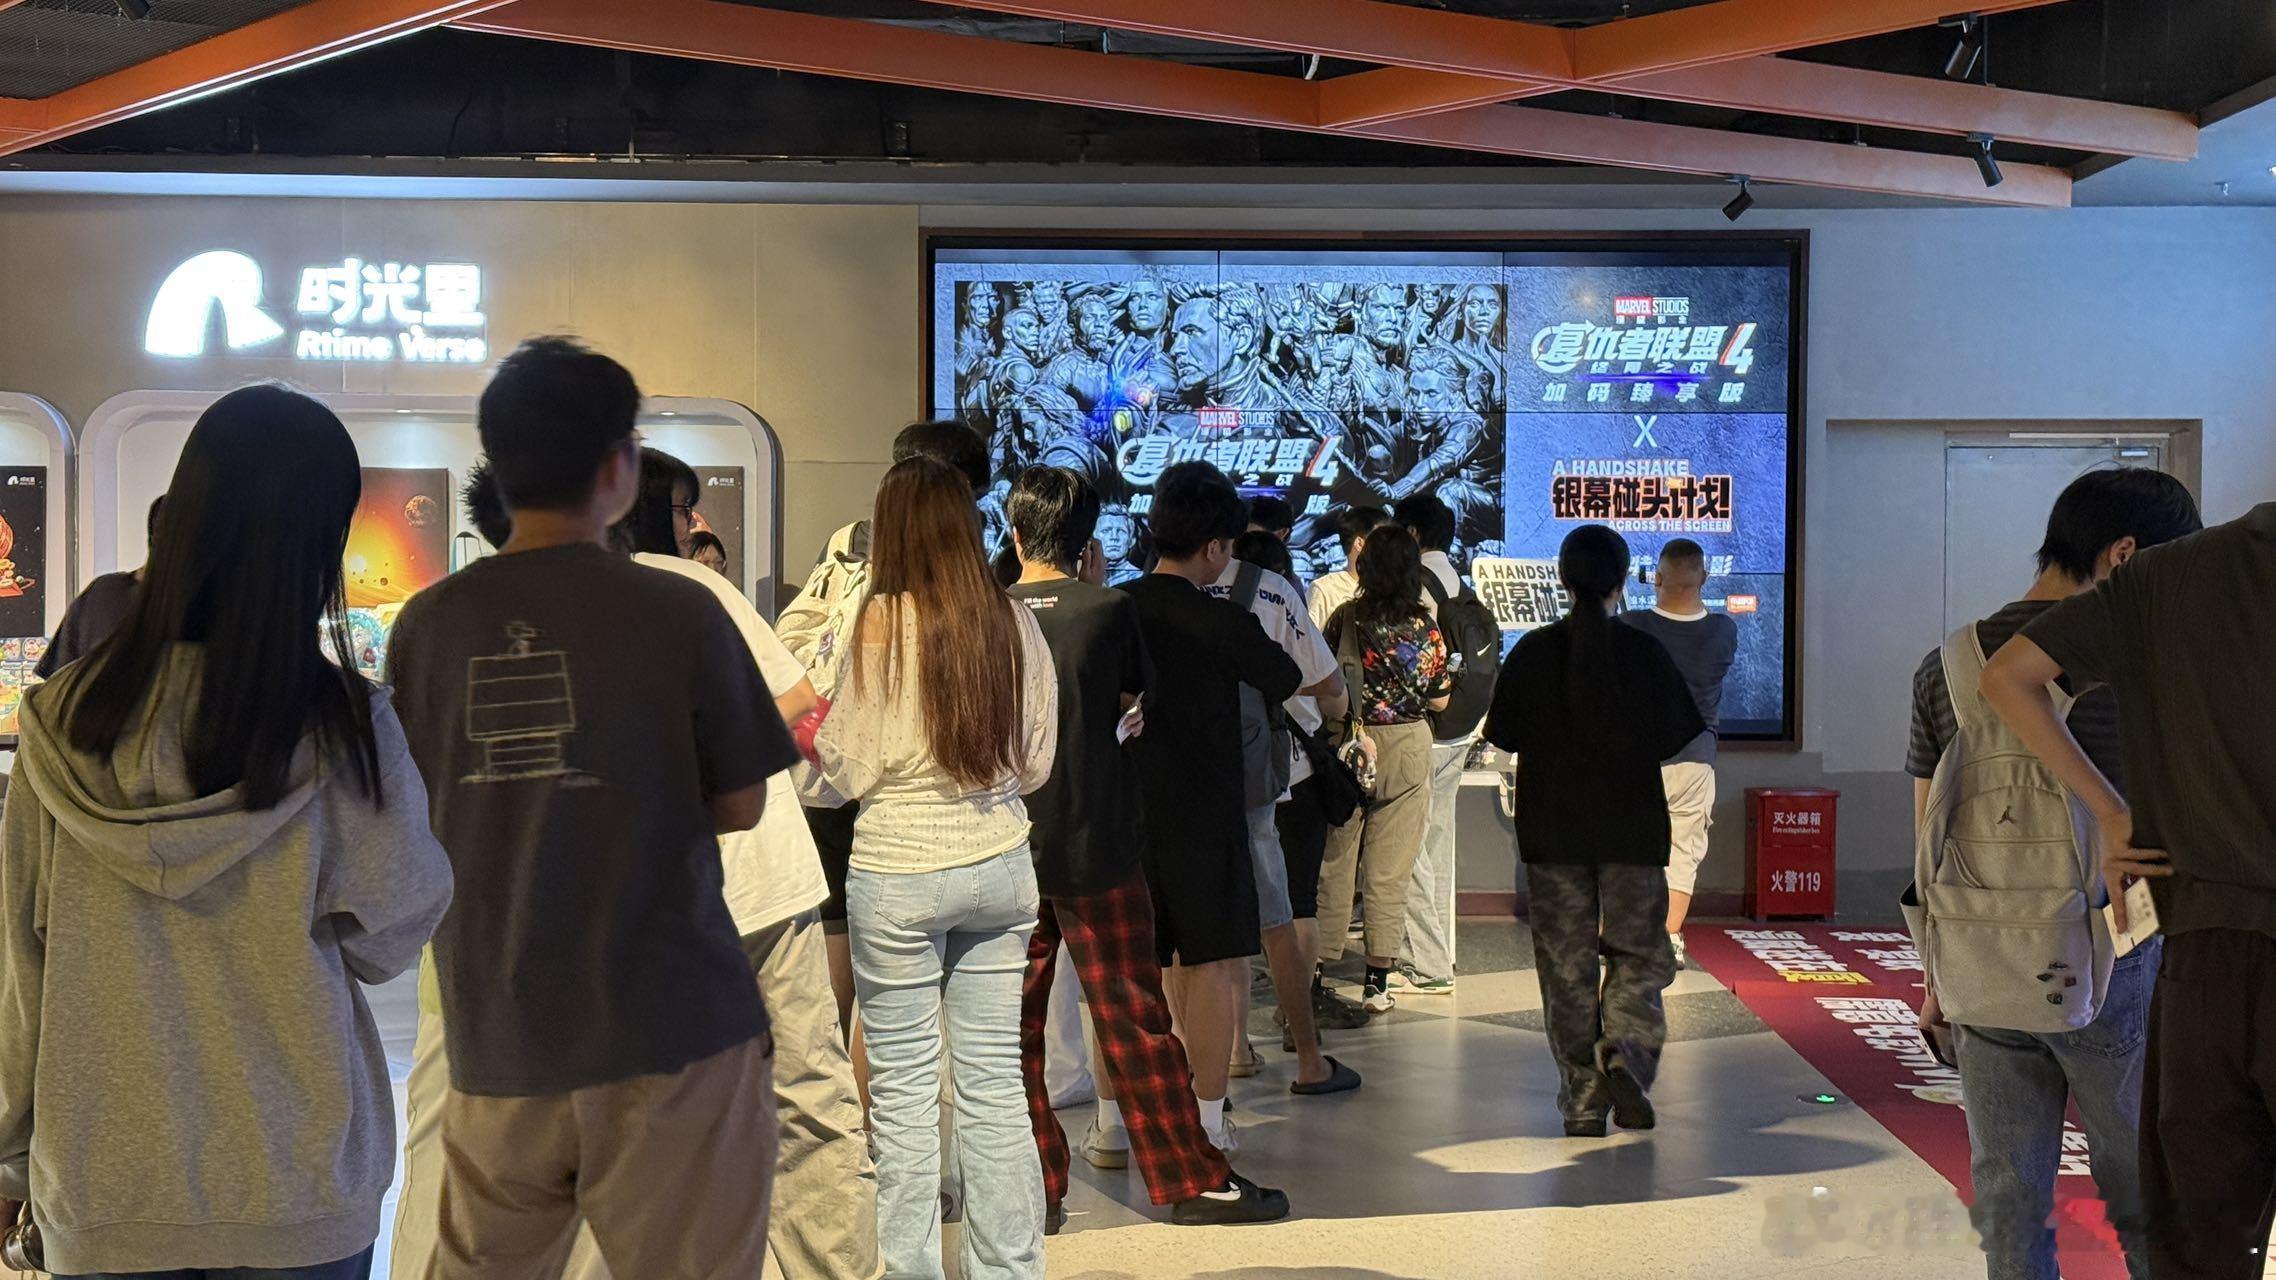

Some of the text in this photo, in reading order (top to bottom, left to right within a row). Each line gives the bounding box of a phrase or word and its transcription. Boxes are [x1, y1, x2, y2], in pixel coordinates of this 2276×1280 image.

[299, 258, 485, 326] 时光里
[1615, 297, 1690, 315] MARVEL STUDIOS
[298, 329, 393, 361] Rtime
[1238, 410, 1275, 426] STUDIOS
[1552, 459, 1689, 476] A HANDSHAKE
[1552, 475, 1732, 520] 银幕碰头计划!
[1608, 520, 1731, 532] ACROSS THE SCREEN
[1478, 564, 1558, 580] A HANDSH
[1773, 811, 1821, 826] 灭火器箱
[1770, 869, 1821, 892] 火警119
